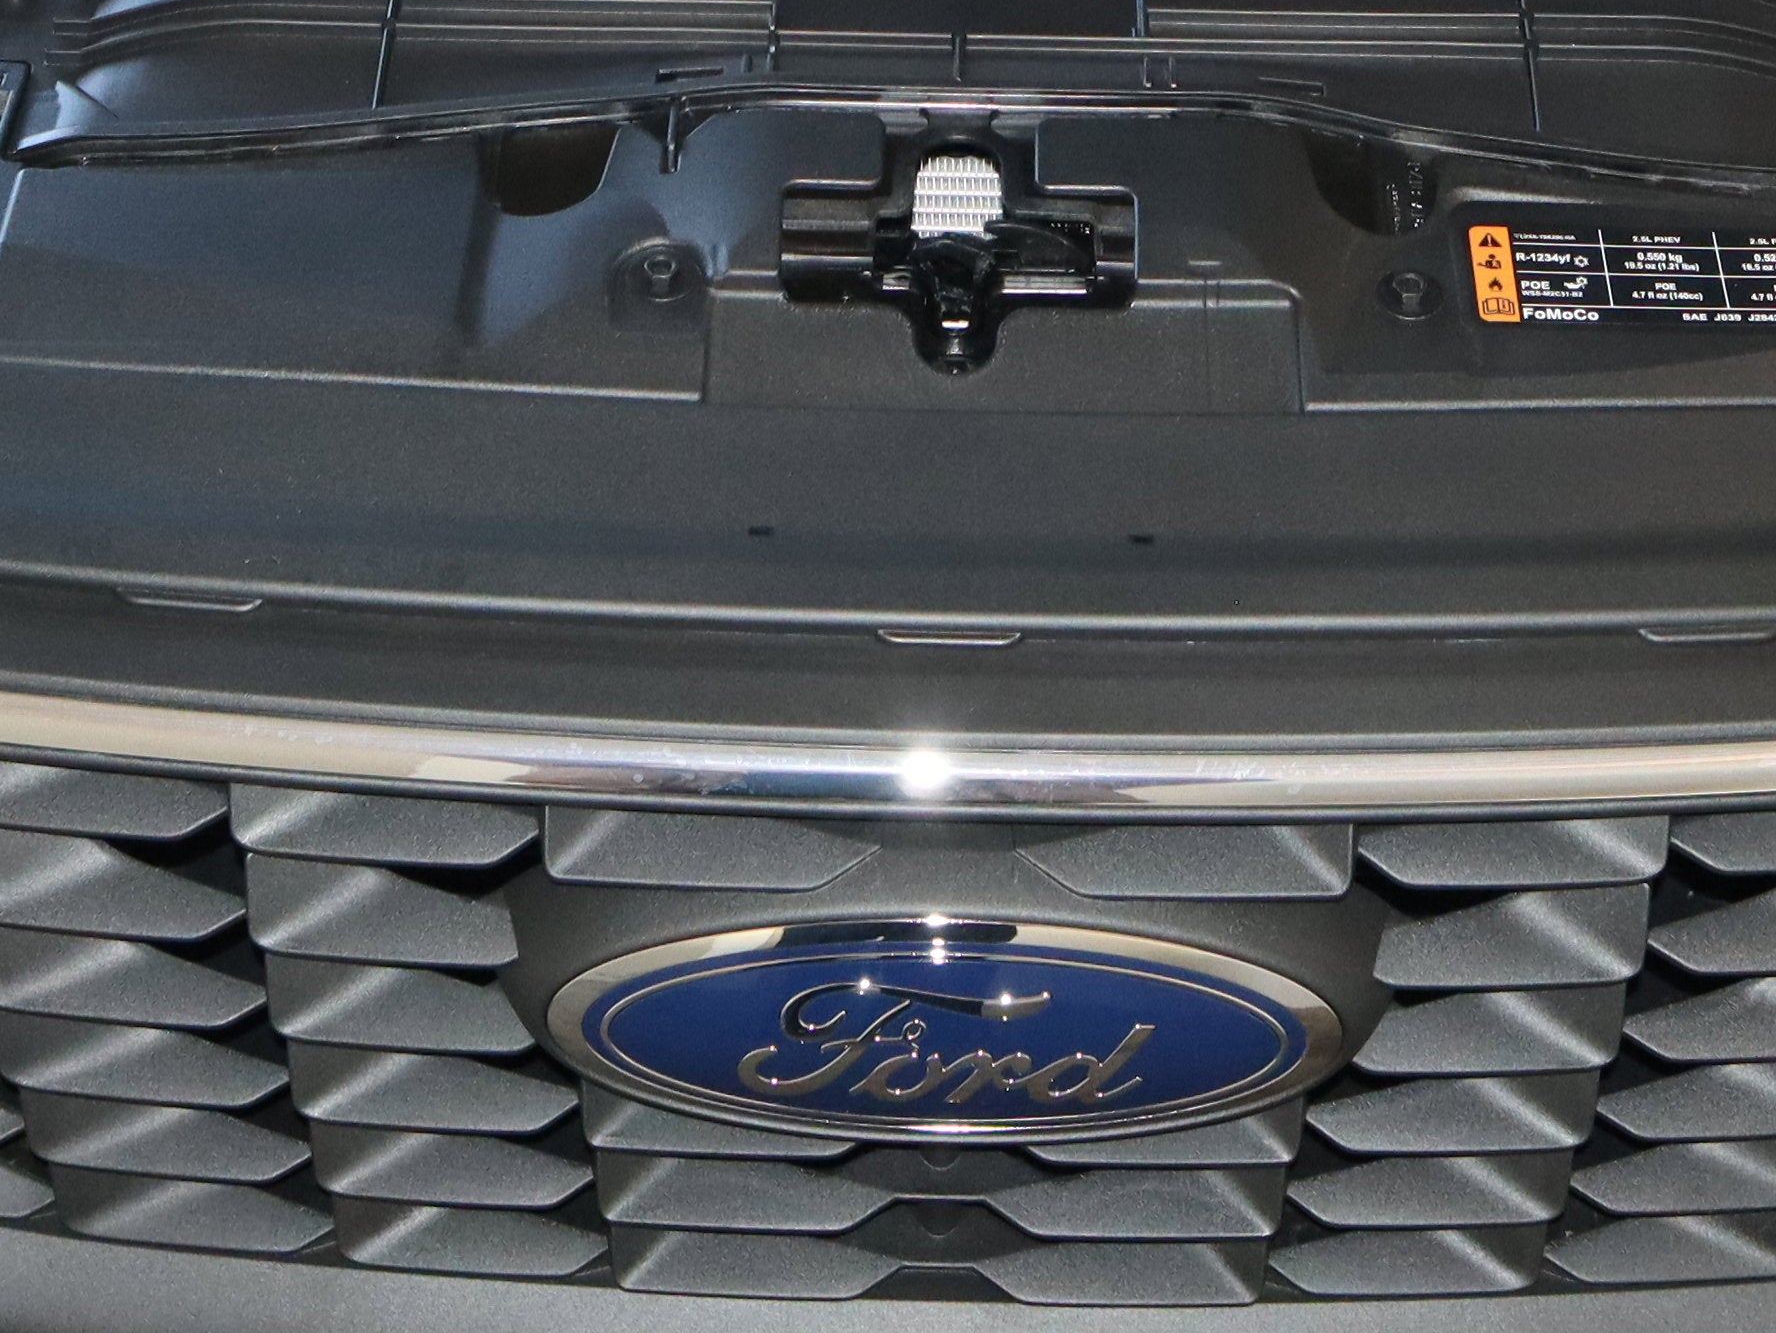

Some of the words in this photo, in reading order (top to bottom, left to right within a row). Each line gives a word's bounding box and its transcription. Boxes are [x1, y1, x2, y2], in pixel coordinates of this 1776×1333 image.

[1515, 252, 1571, 264] R-1234yf
[1637, 252, 1667, 261] 0.550
[1668, 253, 1683, 263] kg
[1521, 280, 1550, 290] POE
[1654, 282, 1677, 290] POE
[1522, 307, 1600, 321] FoMoCo
[737, 981, 1158, 1106] Ford
